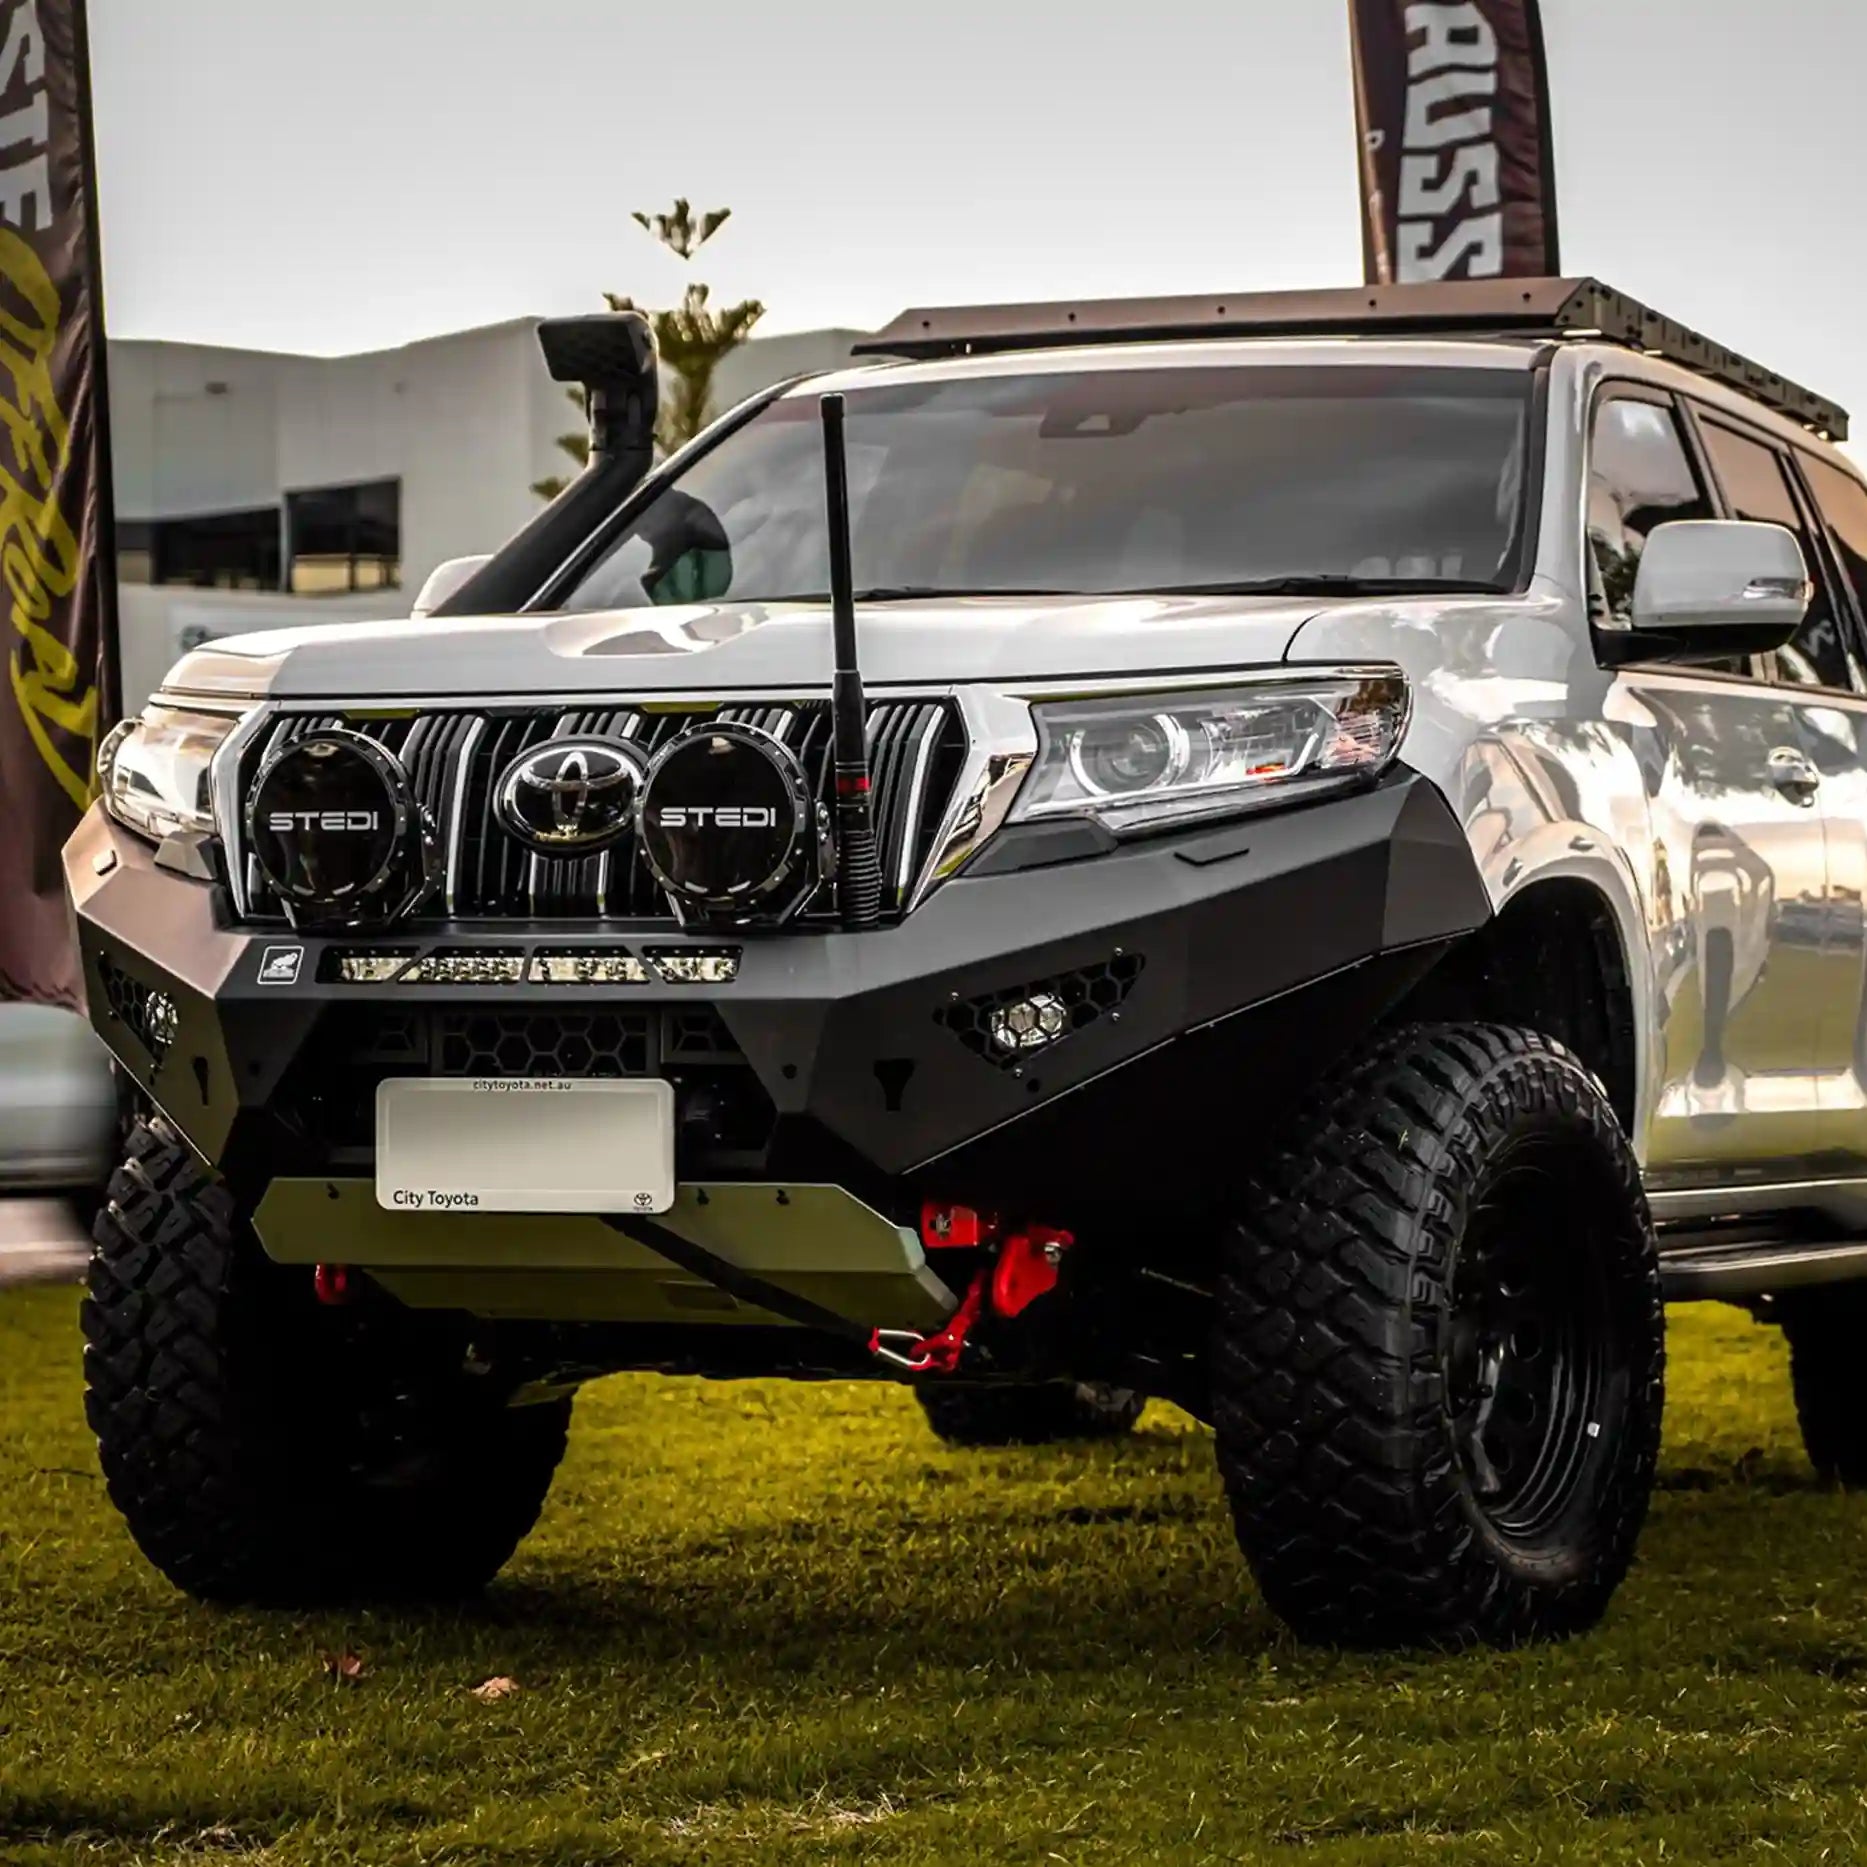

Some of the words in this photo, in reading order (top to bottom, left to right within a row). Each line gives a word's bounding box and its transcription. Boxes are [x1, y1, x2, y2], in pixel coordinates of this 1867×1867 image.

[269, 811, 378, 831] STEDI
[660, 807, 776, 827] STEDI
[473, 1079, 572, 1091] citytoyota.net.au
[393, 1190, 424, 1208] City
[428, 1191, 479, 1208] Toyota
